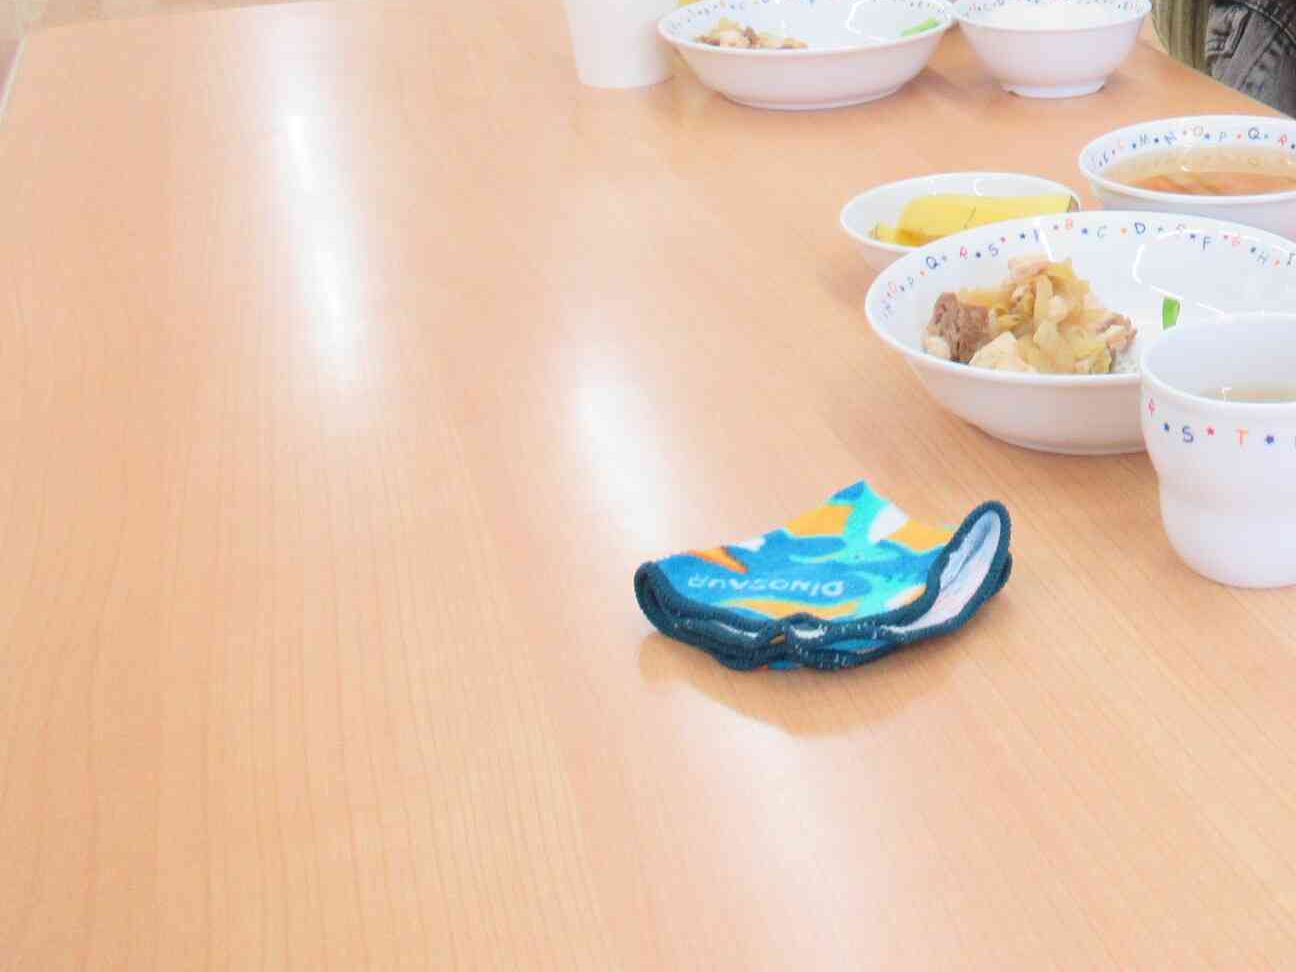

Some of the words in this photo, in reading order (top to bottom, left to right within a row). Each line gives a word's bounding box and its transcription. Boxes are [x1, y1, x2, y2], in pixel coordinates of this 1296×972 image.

[1181, 425, 1195, 444] S
[1236, 428, 1250, 446] T
[687, 574, 846, 597] DINOSAUR
